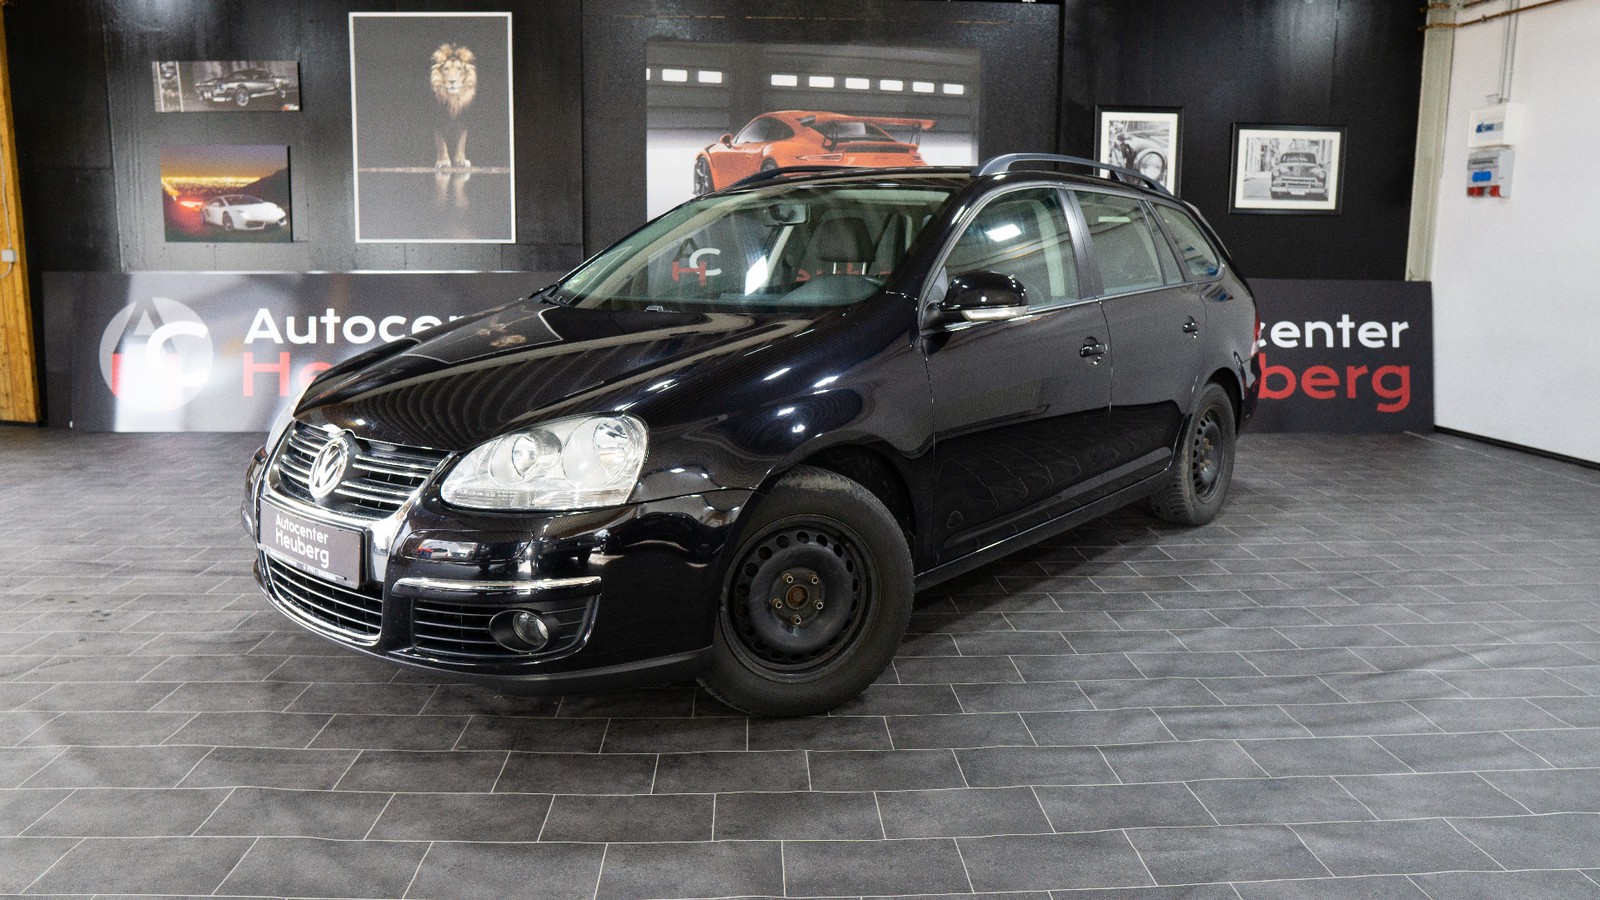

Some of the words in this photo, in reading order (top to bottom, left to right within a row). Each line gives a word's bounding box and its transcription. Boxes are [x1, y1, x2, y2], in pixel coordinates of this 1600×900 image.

[243, 307, 466, 345] Autoce
[1257, 352, 1411, 413] berg
[275, 513, 329, 545] Autocenter
[275, 526, 330, 569] Heuberg
